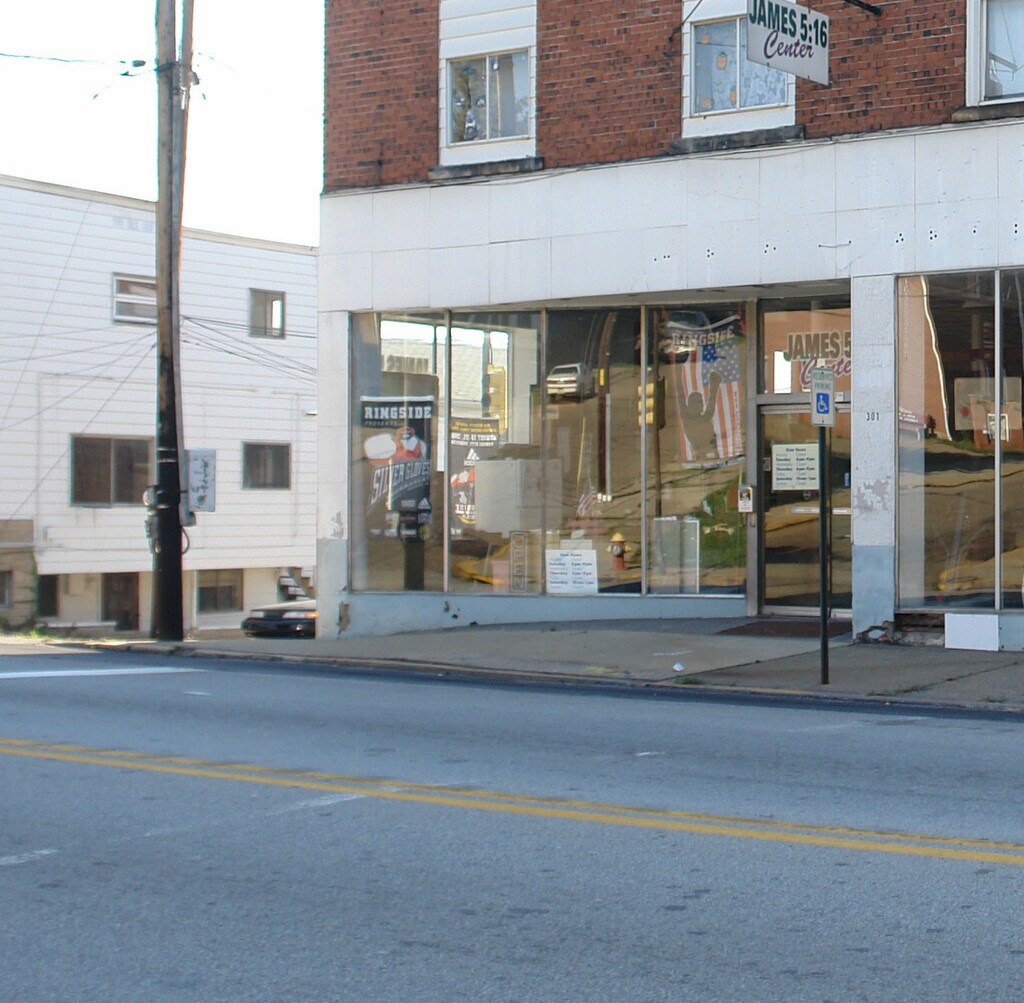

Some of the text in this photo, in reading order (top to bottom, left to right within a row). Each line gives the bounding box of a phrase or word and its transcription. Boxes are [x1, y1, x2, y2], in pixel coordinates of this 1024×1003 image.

[763, 30, 815, 59] Center
[800, 14, 828, 48] 5:16
[783, 331, 841, 362] JAMES
[364, 406, 432, 420] RINGSIDE
[866, 412, 880, 422] 301
[513, 535, 525, 590] OPEN
